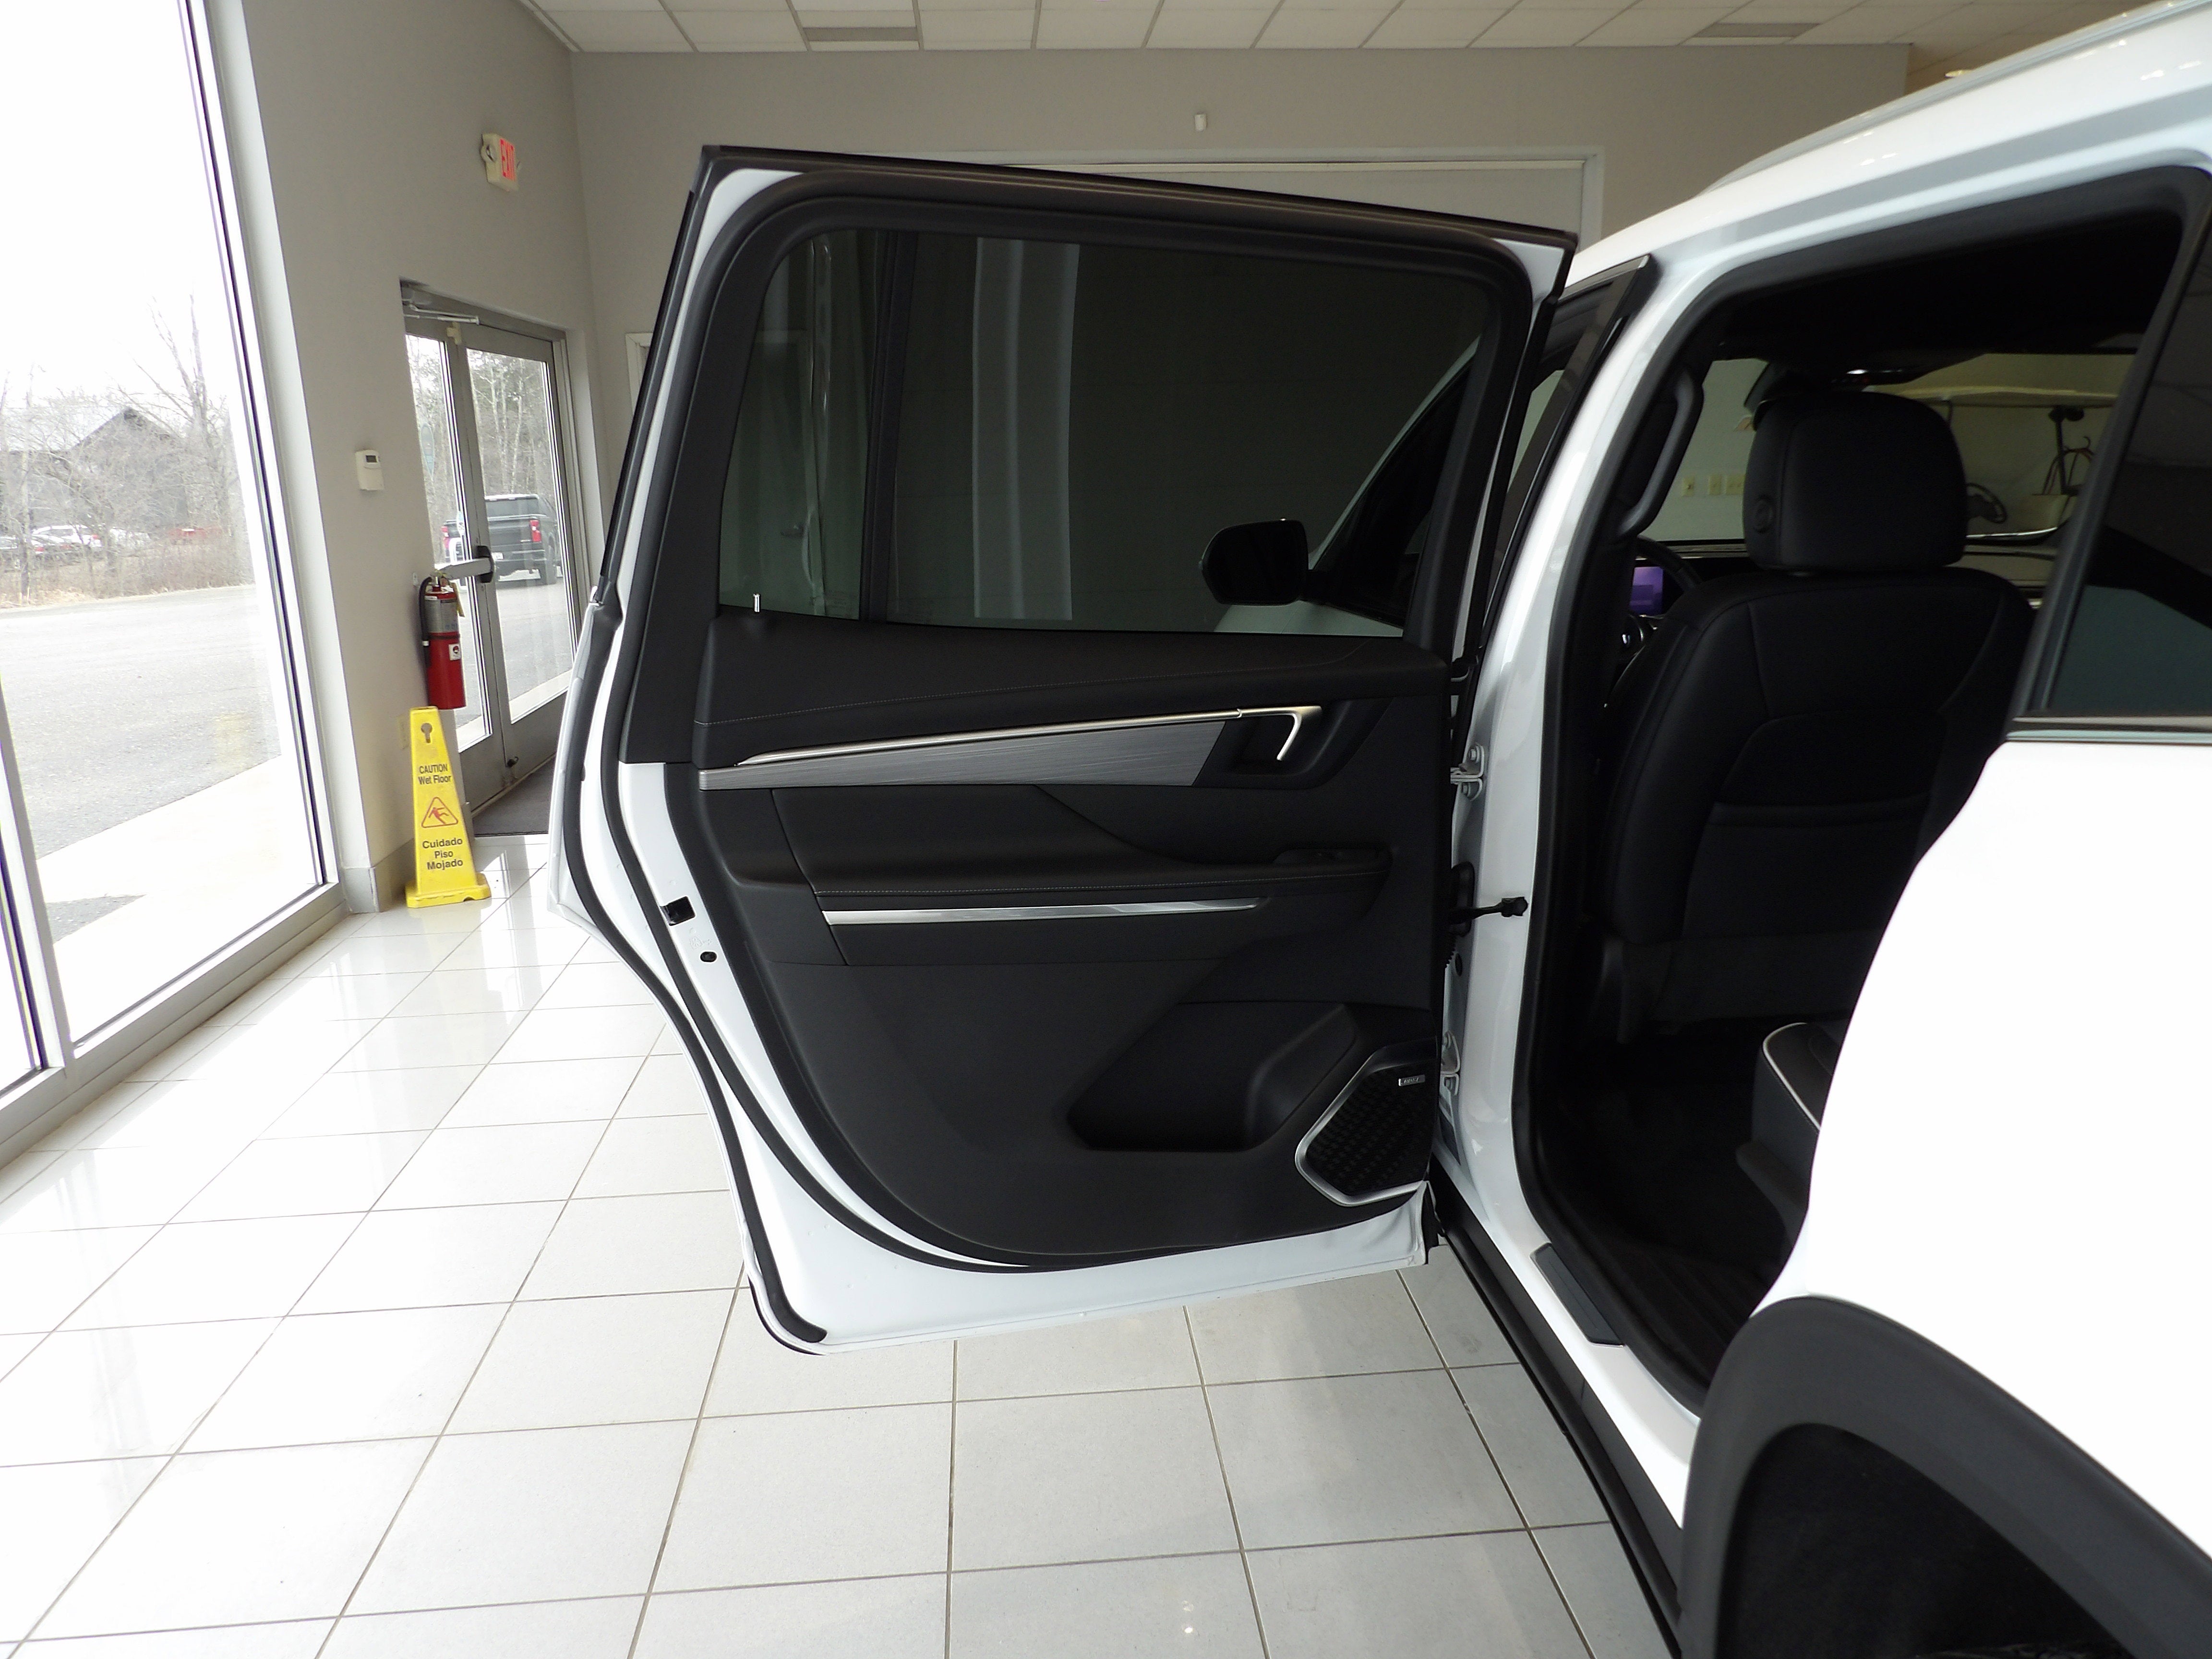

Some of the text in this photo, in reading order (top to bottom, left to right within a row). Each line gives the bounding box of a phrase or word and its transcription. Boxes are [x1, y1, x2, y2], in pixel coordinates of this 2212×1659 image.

[419, 764, 448, 774] CAUTION
[418, 775, 451, 785] Wet Floor
[422, 838, 463, 849] Cuidado
[434, 850, 453, 858] Piso
[427, 859, 463, 870] Mojado
